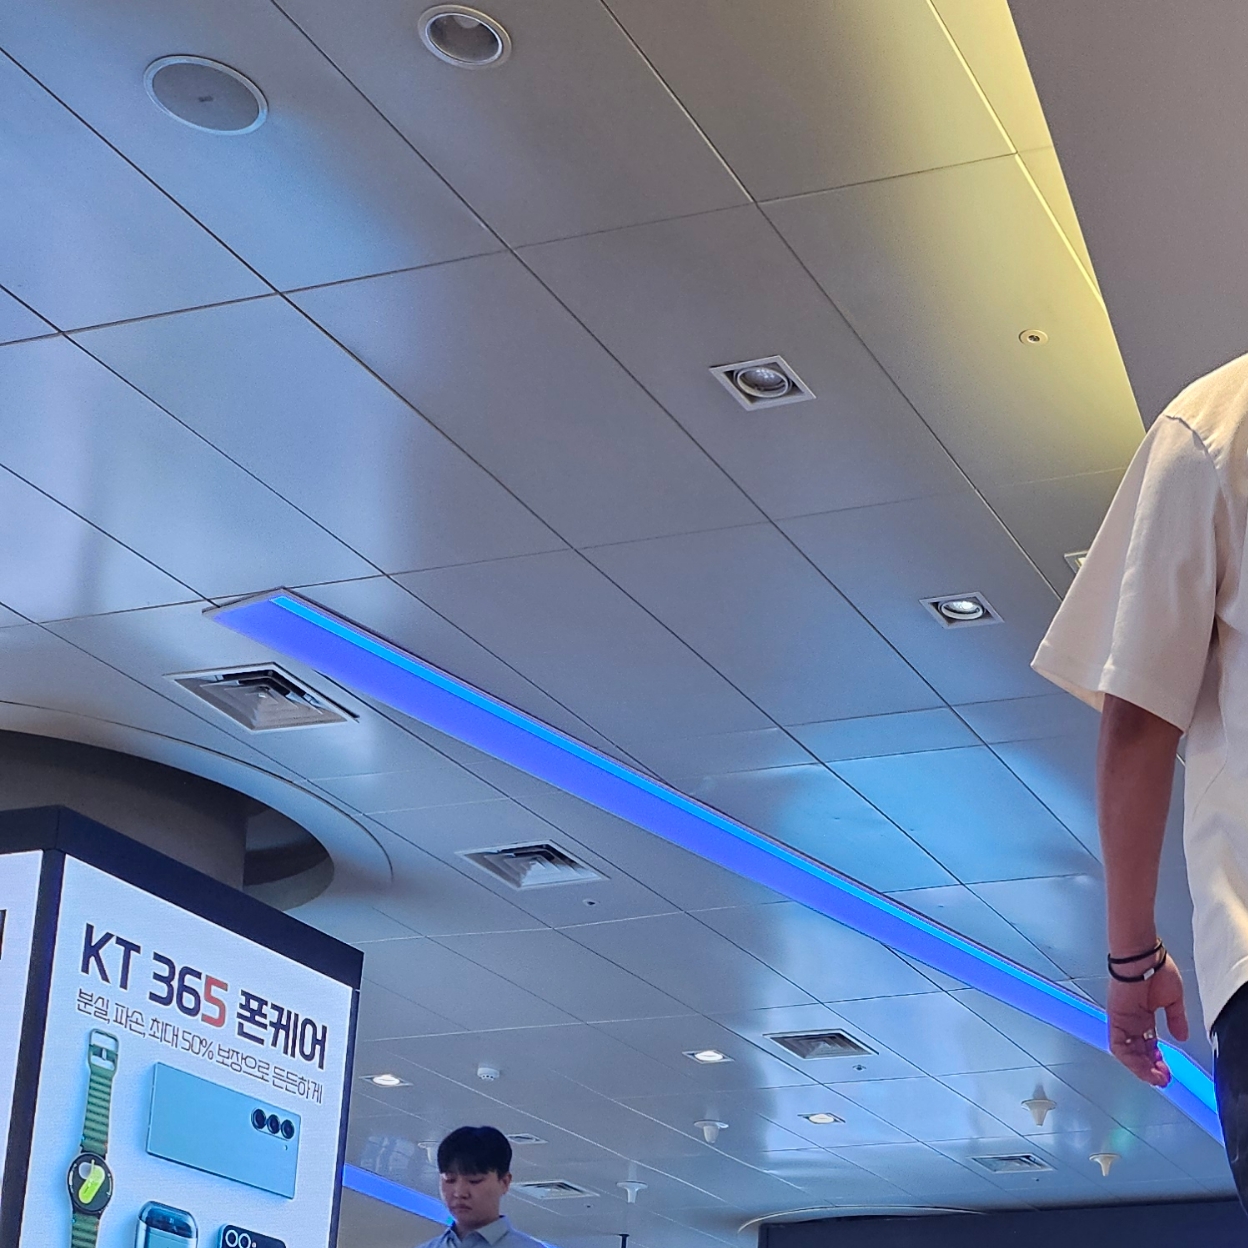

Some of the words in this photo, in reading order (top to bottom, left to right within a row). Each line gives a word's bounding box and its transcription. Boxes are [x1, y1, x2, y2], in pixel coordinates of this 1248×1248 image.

[77, 988, 111, 1024] 분실,
[113, 1002, 146, 1038] 파손,
[148, 1017, 179, 1049] 최대
[181, 1031, 214, 1061] 50%
[216, 1044, 270, 1083] 보장으로
[272, 1066, 323, 1104] 든든하게
[80, 922, 141, 991] KT
[149, 951, 228, 1028] 365
[236, 989, 328, 1070] 폰케어
